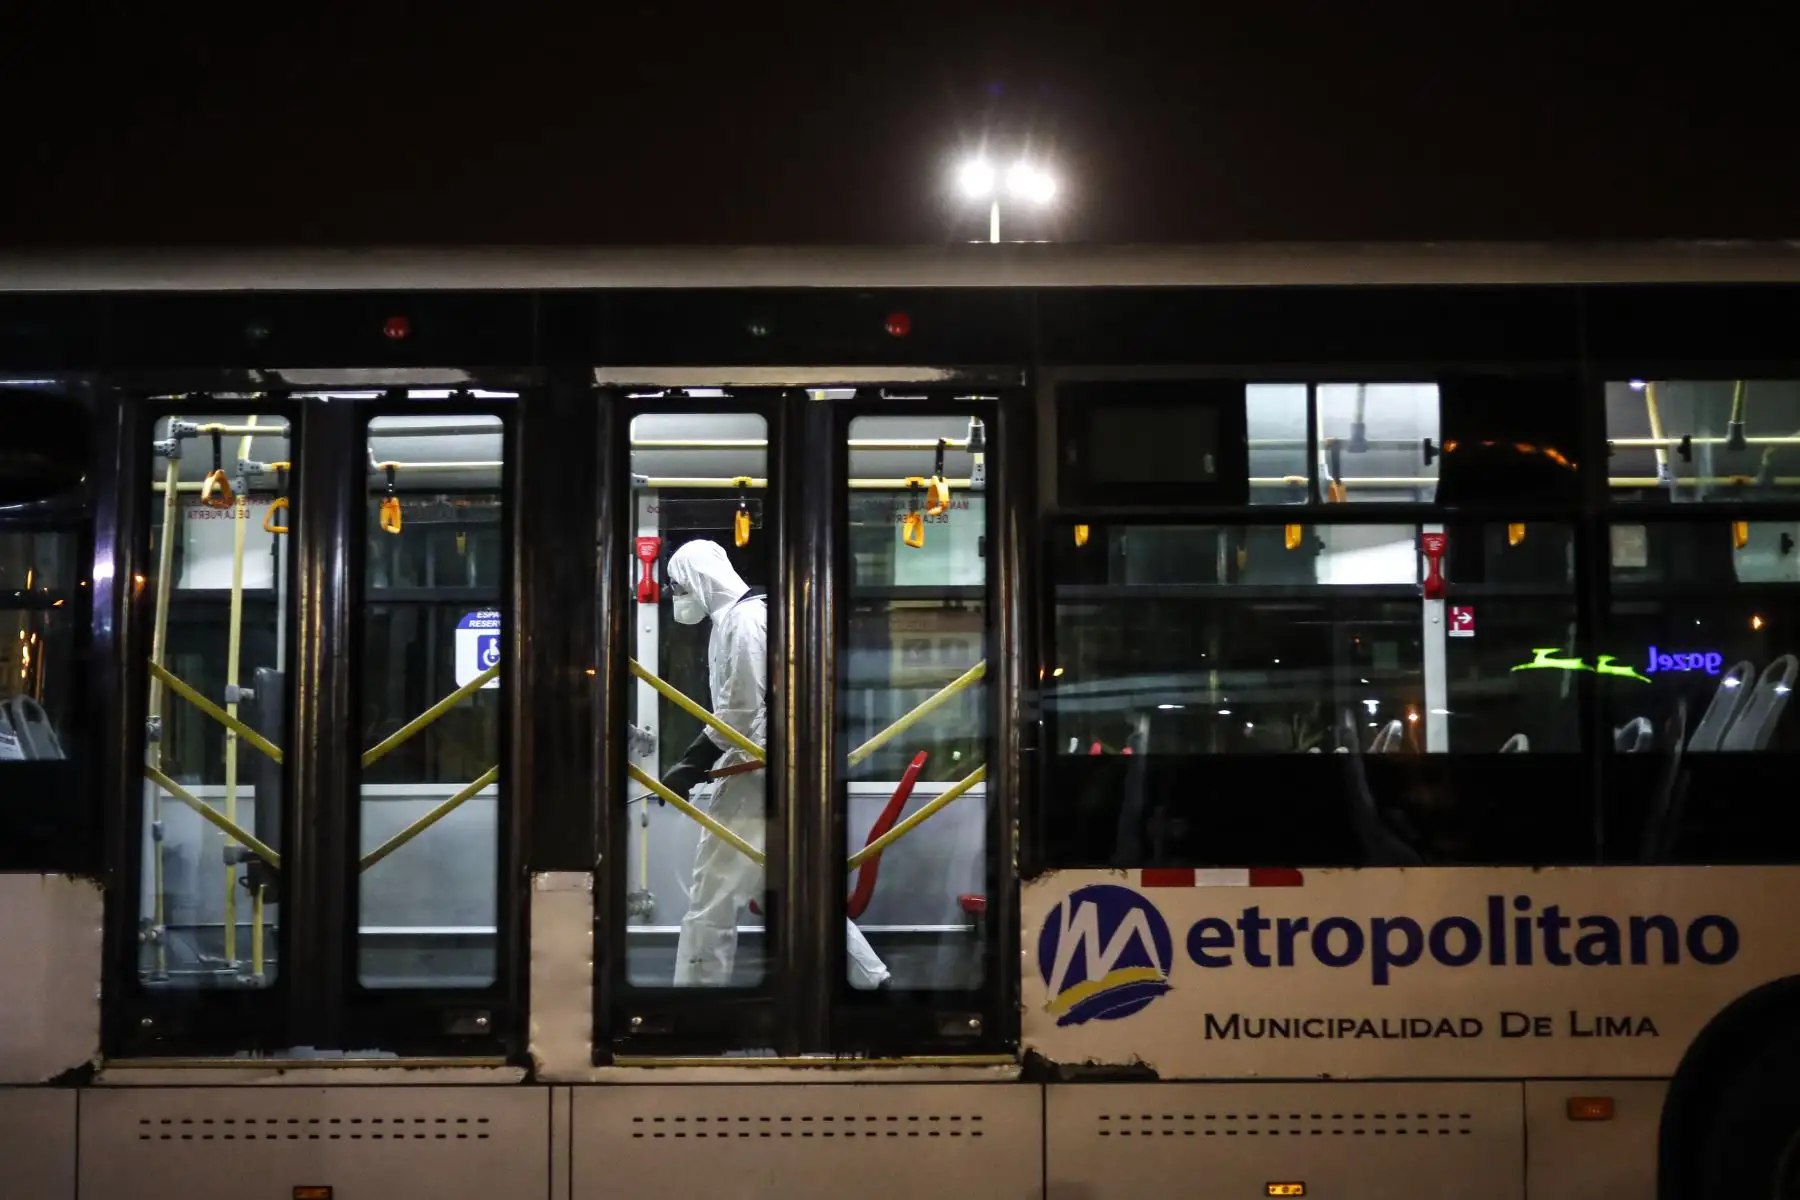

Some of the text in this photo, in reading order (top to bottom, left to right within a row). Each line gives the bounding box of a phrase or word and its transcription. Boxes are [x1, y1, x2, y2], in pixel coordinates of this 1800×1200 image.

[1203, 1011, 1659, 1040] MUNICIPALIDAD DE LIMA
